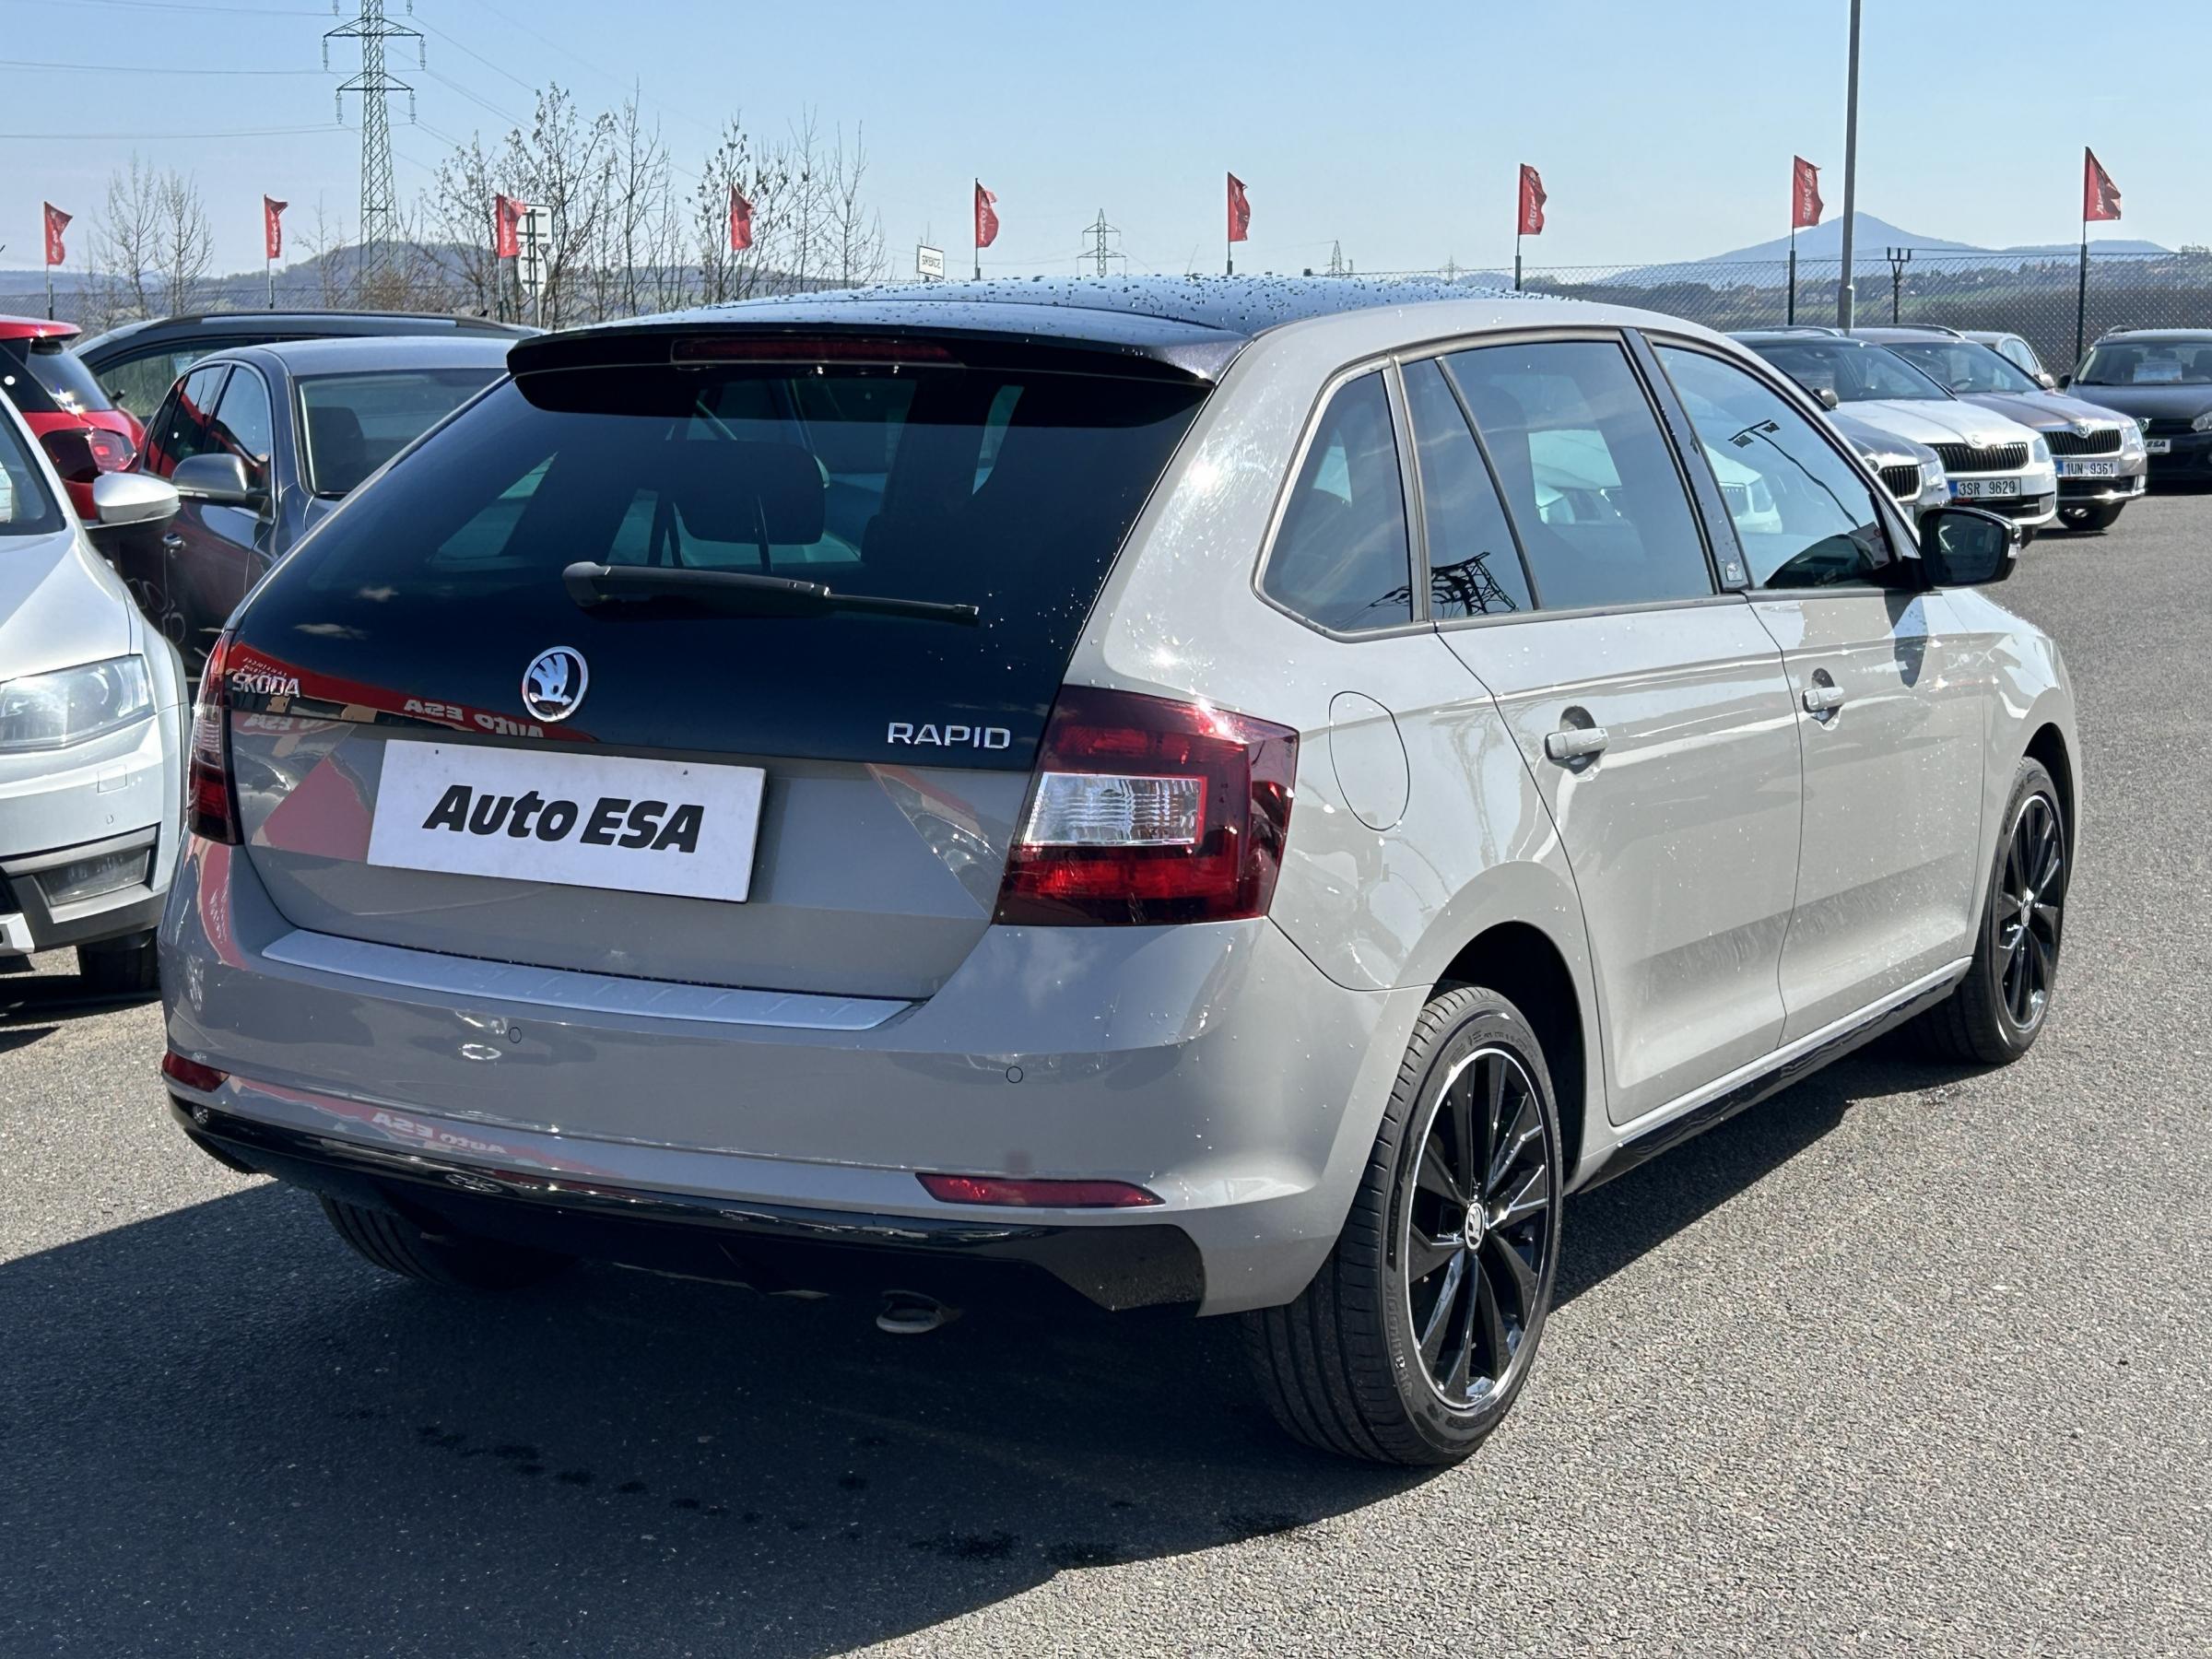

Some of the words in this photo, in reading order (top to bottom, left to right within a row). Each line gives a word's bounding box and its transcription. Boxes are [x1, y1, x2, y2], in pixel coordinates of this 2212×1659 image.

[2065, 463, 2083, 475] 1UN
[1959, 482, 1981, 496] 3SR
[1989, 480, 2016, 494] 9629
[887, 722, 1011, 749] RAPID
[421, 784, 579, 842] Auto
[580, 797, 705, 853] ESA
